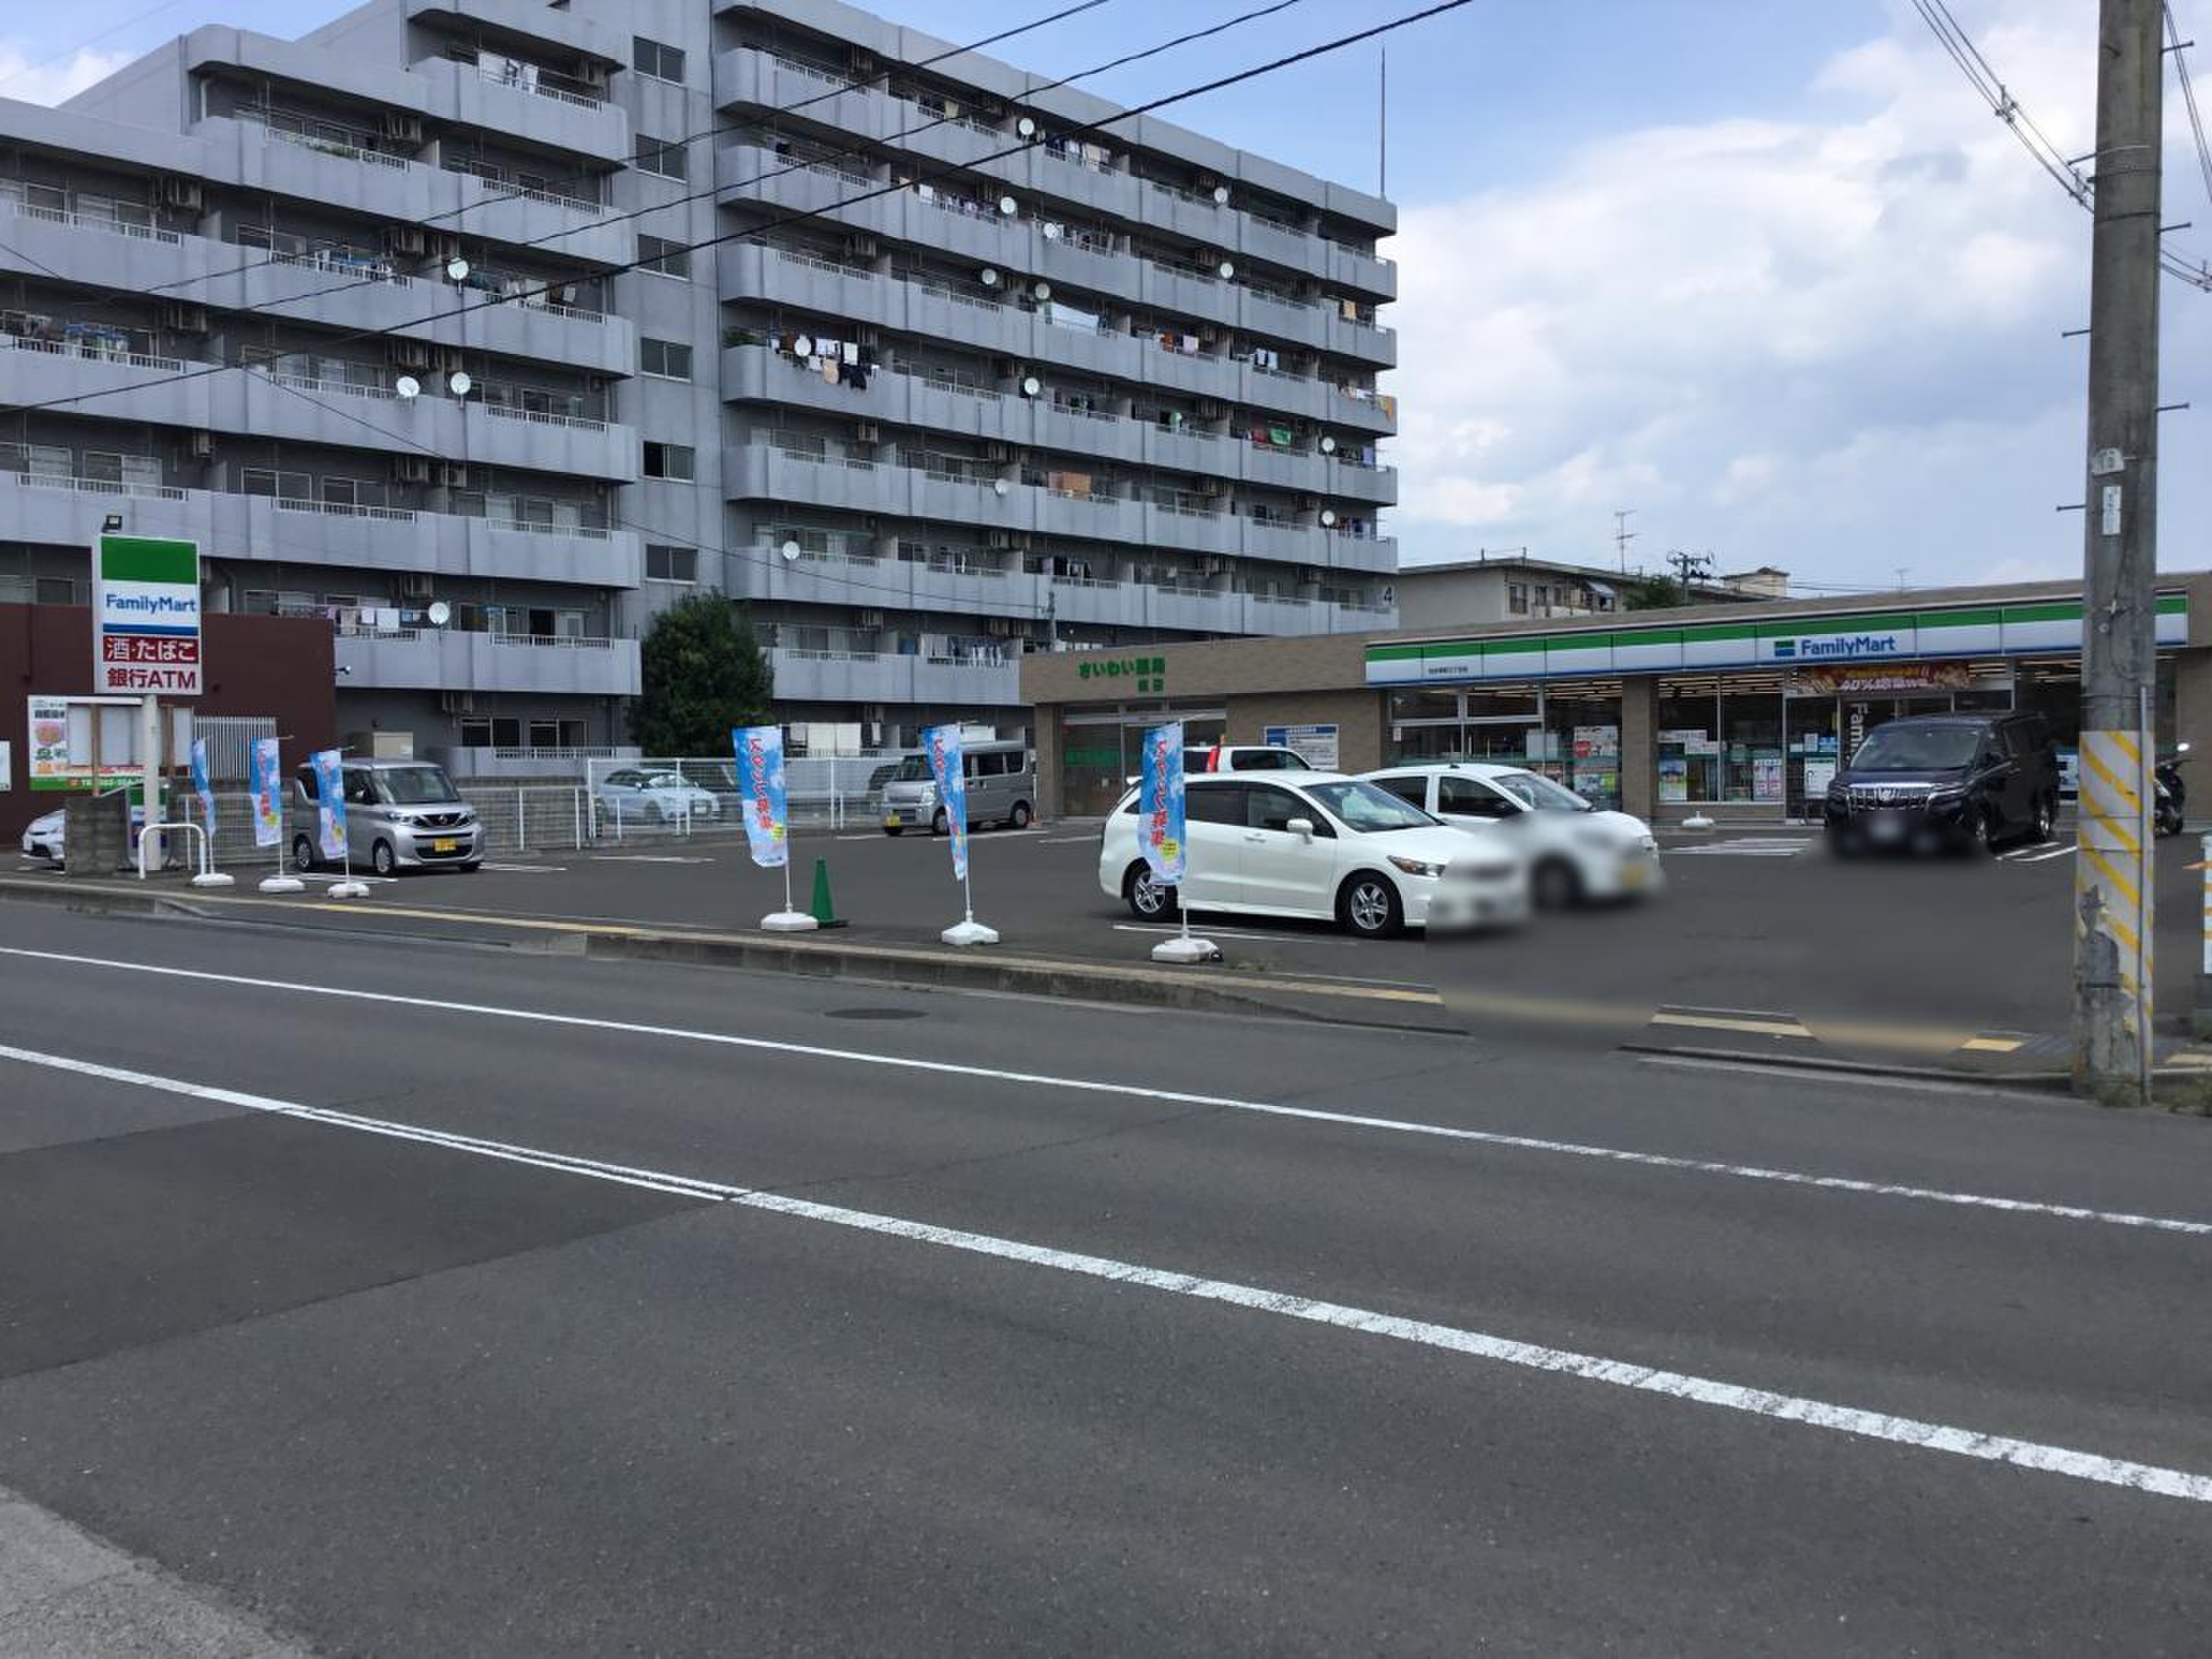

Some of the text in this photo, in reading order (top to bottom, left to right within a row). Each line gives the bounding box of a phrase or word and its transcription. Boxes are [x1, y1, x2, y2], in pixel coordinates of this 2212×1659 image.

[106, 594, 196, 615] FamilyMart
[106, 637, 195, 661] 酒・たばこ
[1801, 635, 1896, 656] FamilyMart
[107, 667, 196, 689] 銀行ATM
